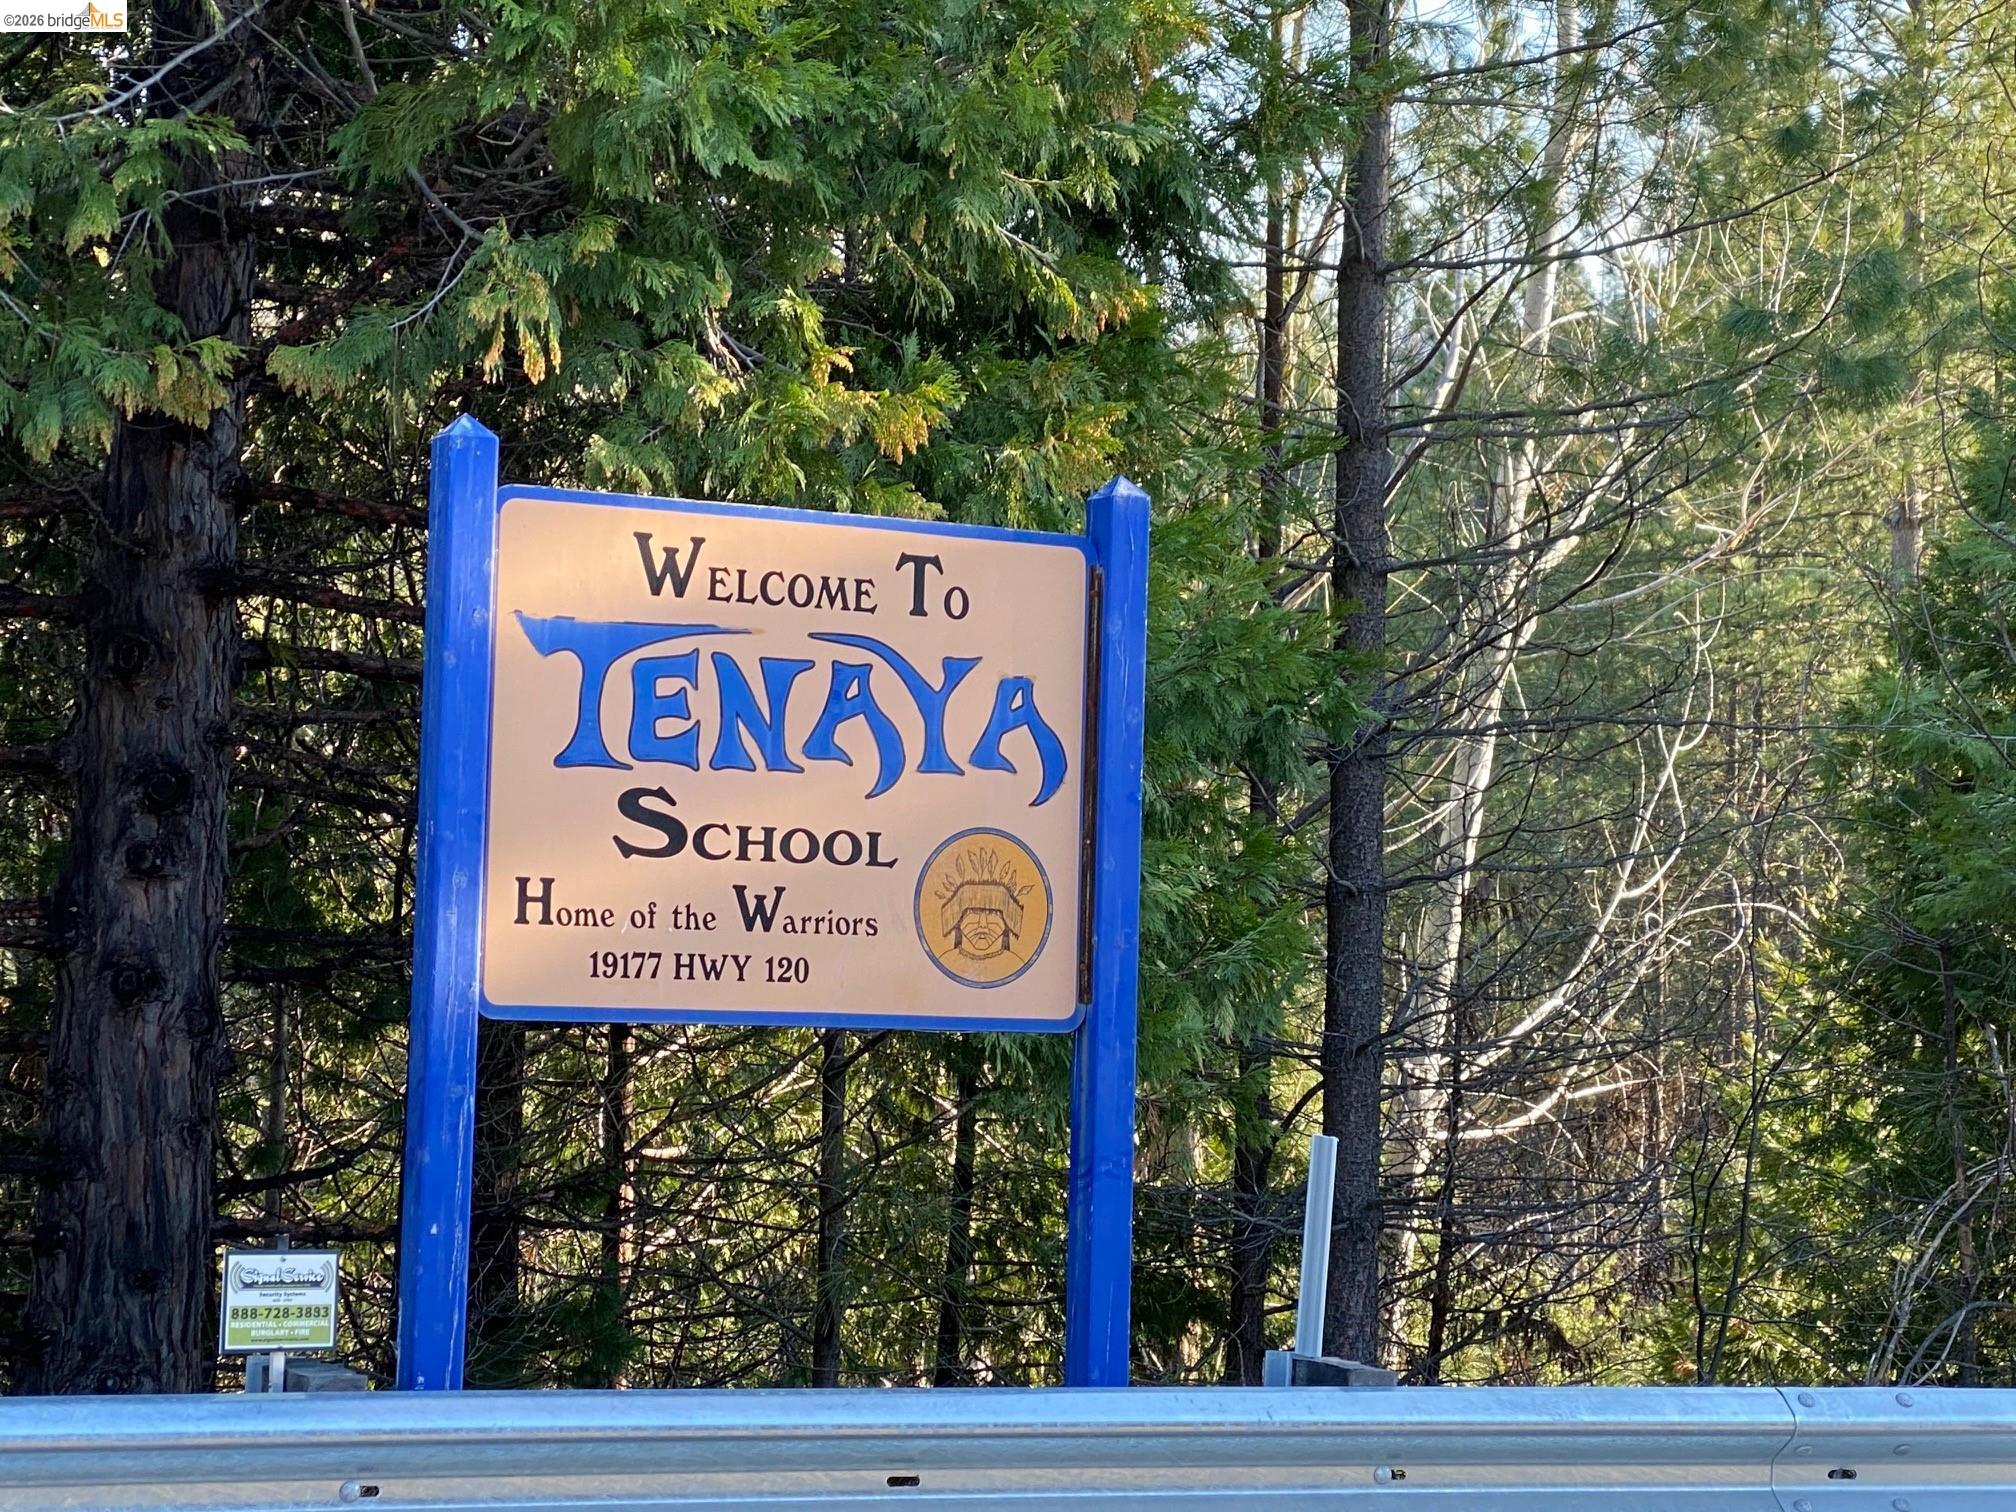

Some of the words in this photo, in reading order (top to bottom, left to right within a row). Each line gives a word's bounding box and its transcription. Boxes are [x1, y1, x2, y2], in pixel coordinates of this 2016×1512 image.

[514, 610, 1067, 806] TENAYA
[514, 876, 616, 928] Home
[630, 901, 657, 930] of
[672, 904, 717, 931] the
[733, 884, 879, 937] Warriors
[588, 951, 662, 979] 19177
[673, 953, 752, 982] HWY
[765, 956, 809, 984] 120
[251, 1328, 289, 1336] BURGLARY
[294, 1328, 310, 1336] FIRE
[282, 1320, 329, 1328] COMMERCIAL
